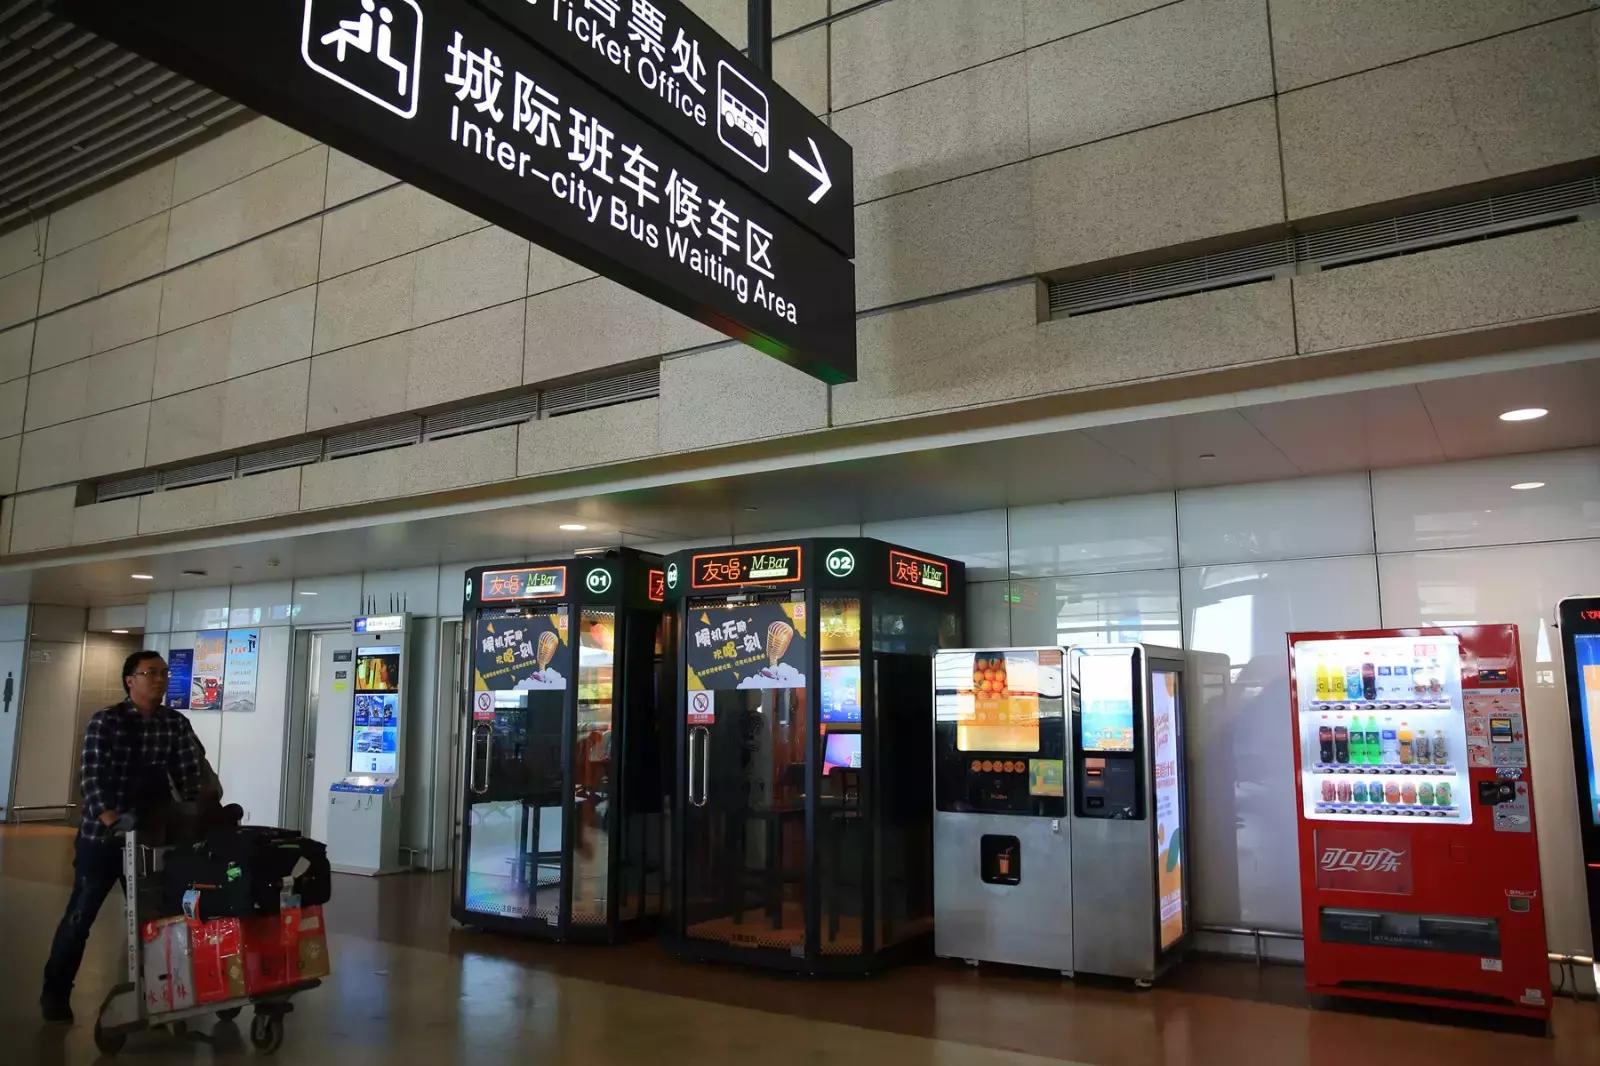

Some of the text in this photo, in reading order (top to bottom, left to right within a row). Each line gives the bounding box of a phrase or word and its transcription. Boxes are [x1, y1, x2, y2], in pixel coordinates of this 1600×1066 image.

[638, 57, 707, 127] Office
[444, 31, 775, 280] 城际班车候车区
[450, 105, 798, 325] Inter-city Bus Waiting Area
[751, 555, 790, 571] M-Bar
[830, 557, 851, 570] 02
[528, 573, 558, 586] M-Bar
[590, 575, 607, 587] 01
[1321, 848, 1406, 872] 可口可乐
